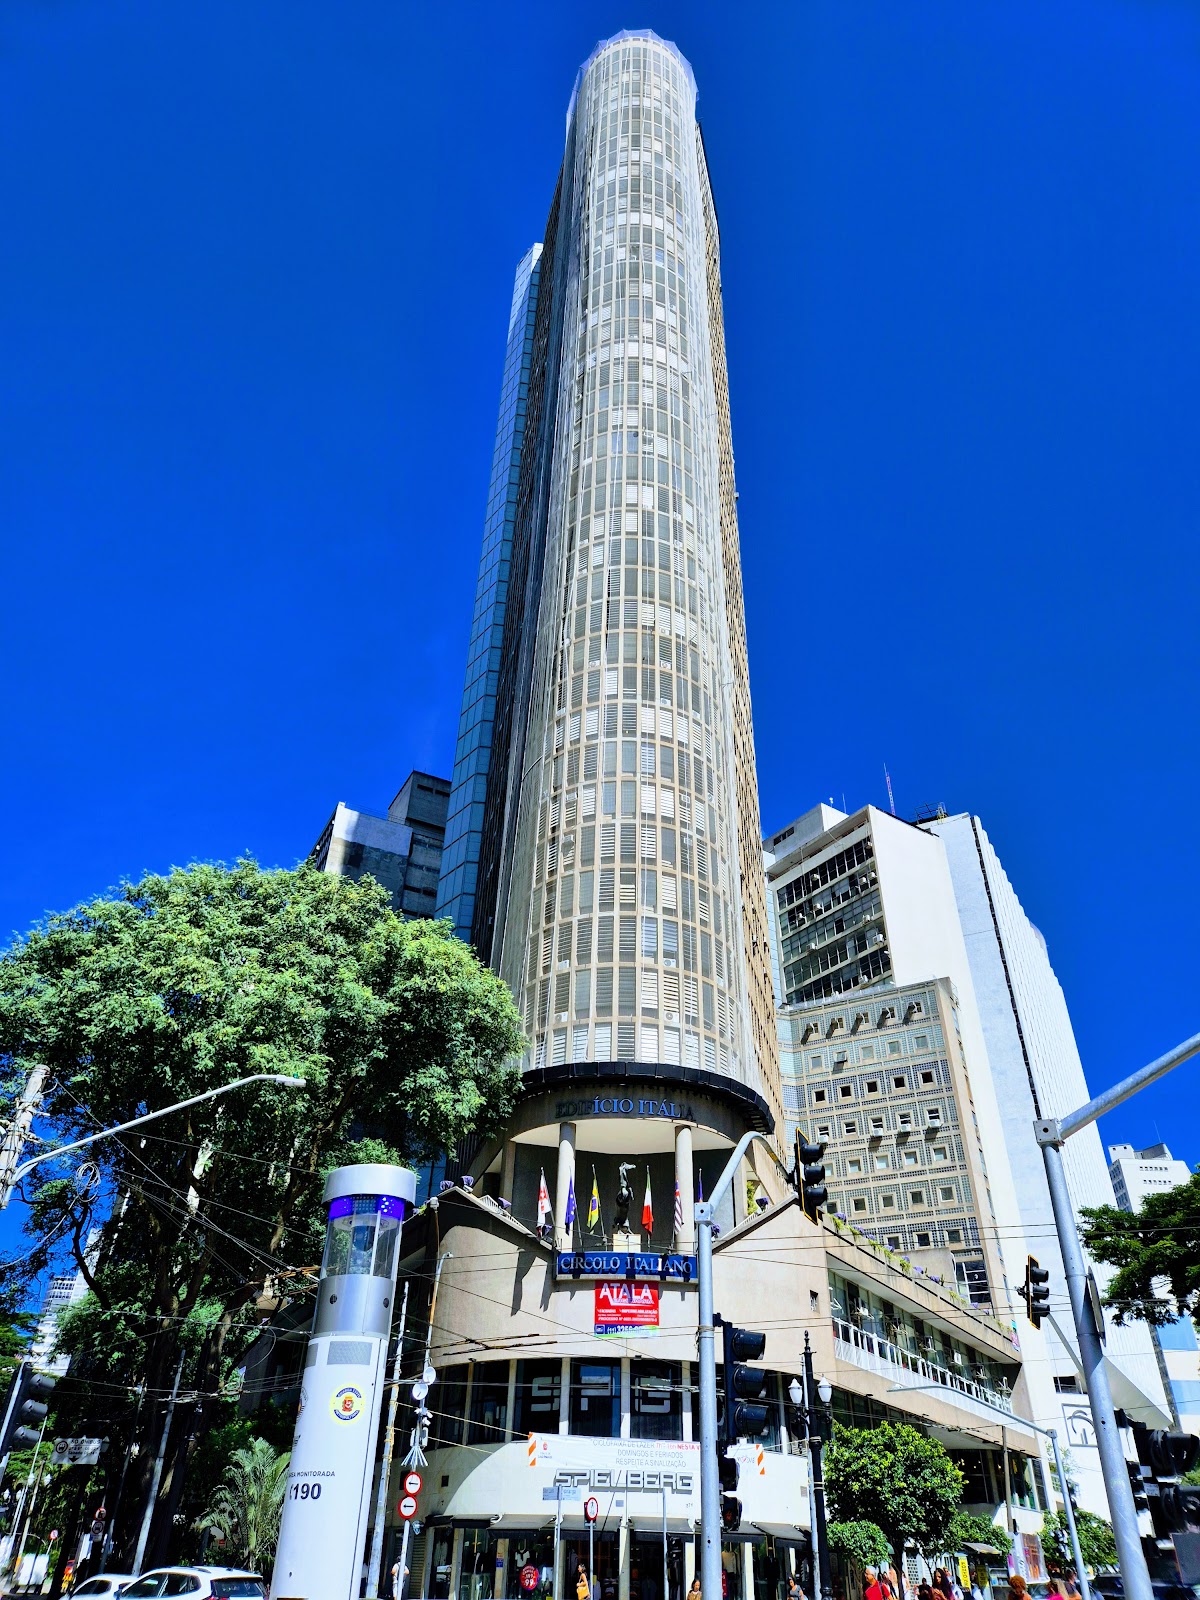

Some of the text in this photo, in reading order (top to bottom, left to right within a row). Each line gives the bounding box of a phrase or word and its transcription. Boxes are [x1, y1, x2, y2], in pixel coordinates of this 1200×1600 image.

[555, 1096, 693, 1120] EDIFÍCIO ITÁLIA
[560, 1256, 692, 1273] CIRCOLO ITALIANO
[599, 1283, 653, 1300] ATALA
[617, 1449, 648, 1457] DOMINGOS
[655, 1451, 684, 1459] FERIADOS
[648, 1458, 687, 1468] SINALIZAÇÃO
[554, 1469, 694, 1491] SPIELBERG
